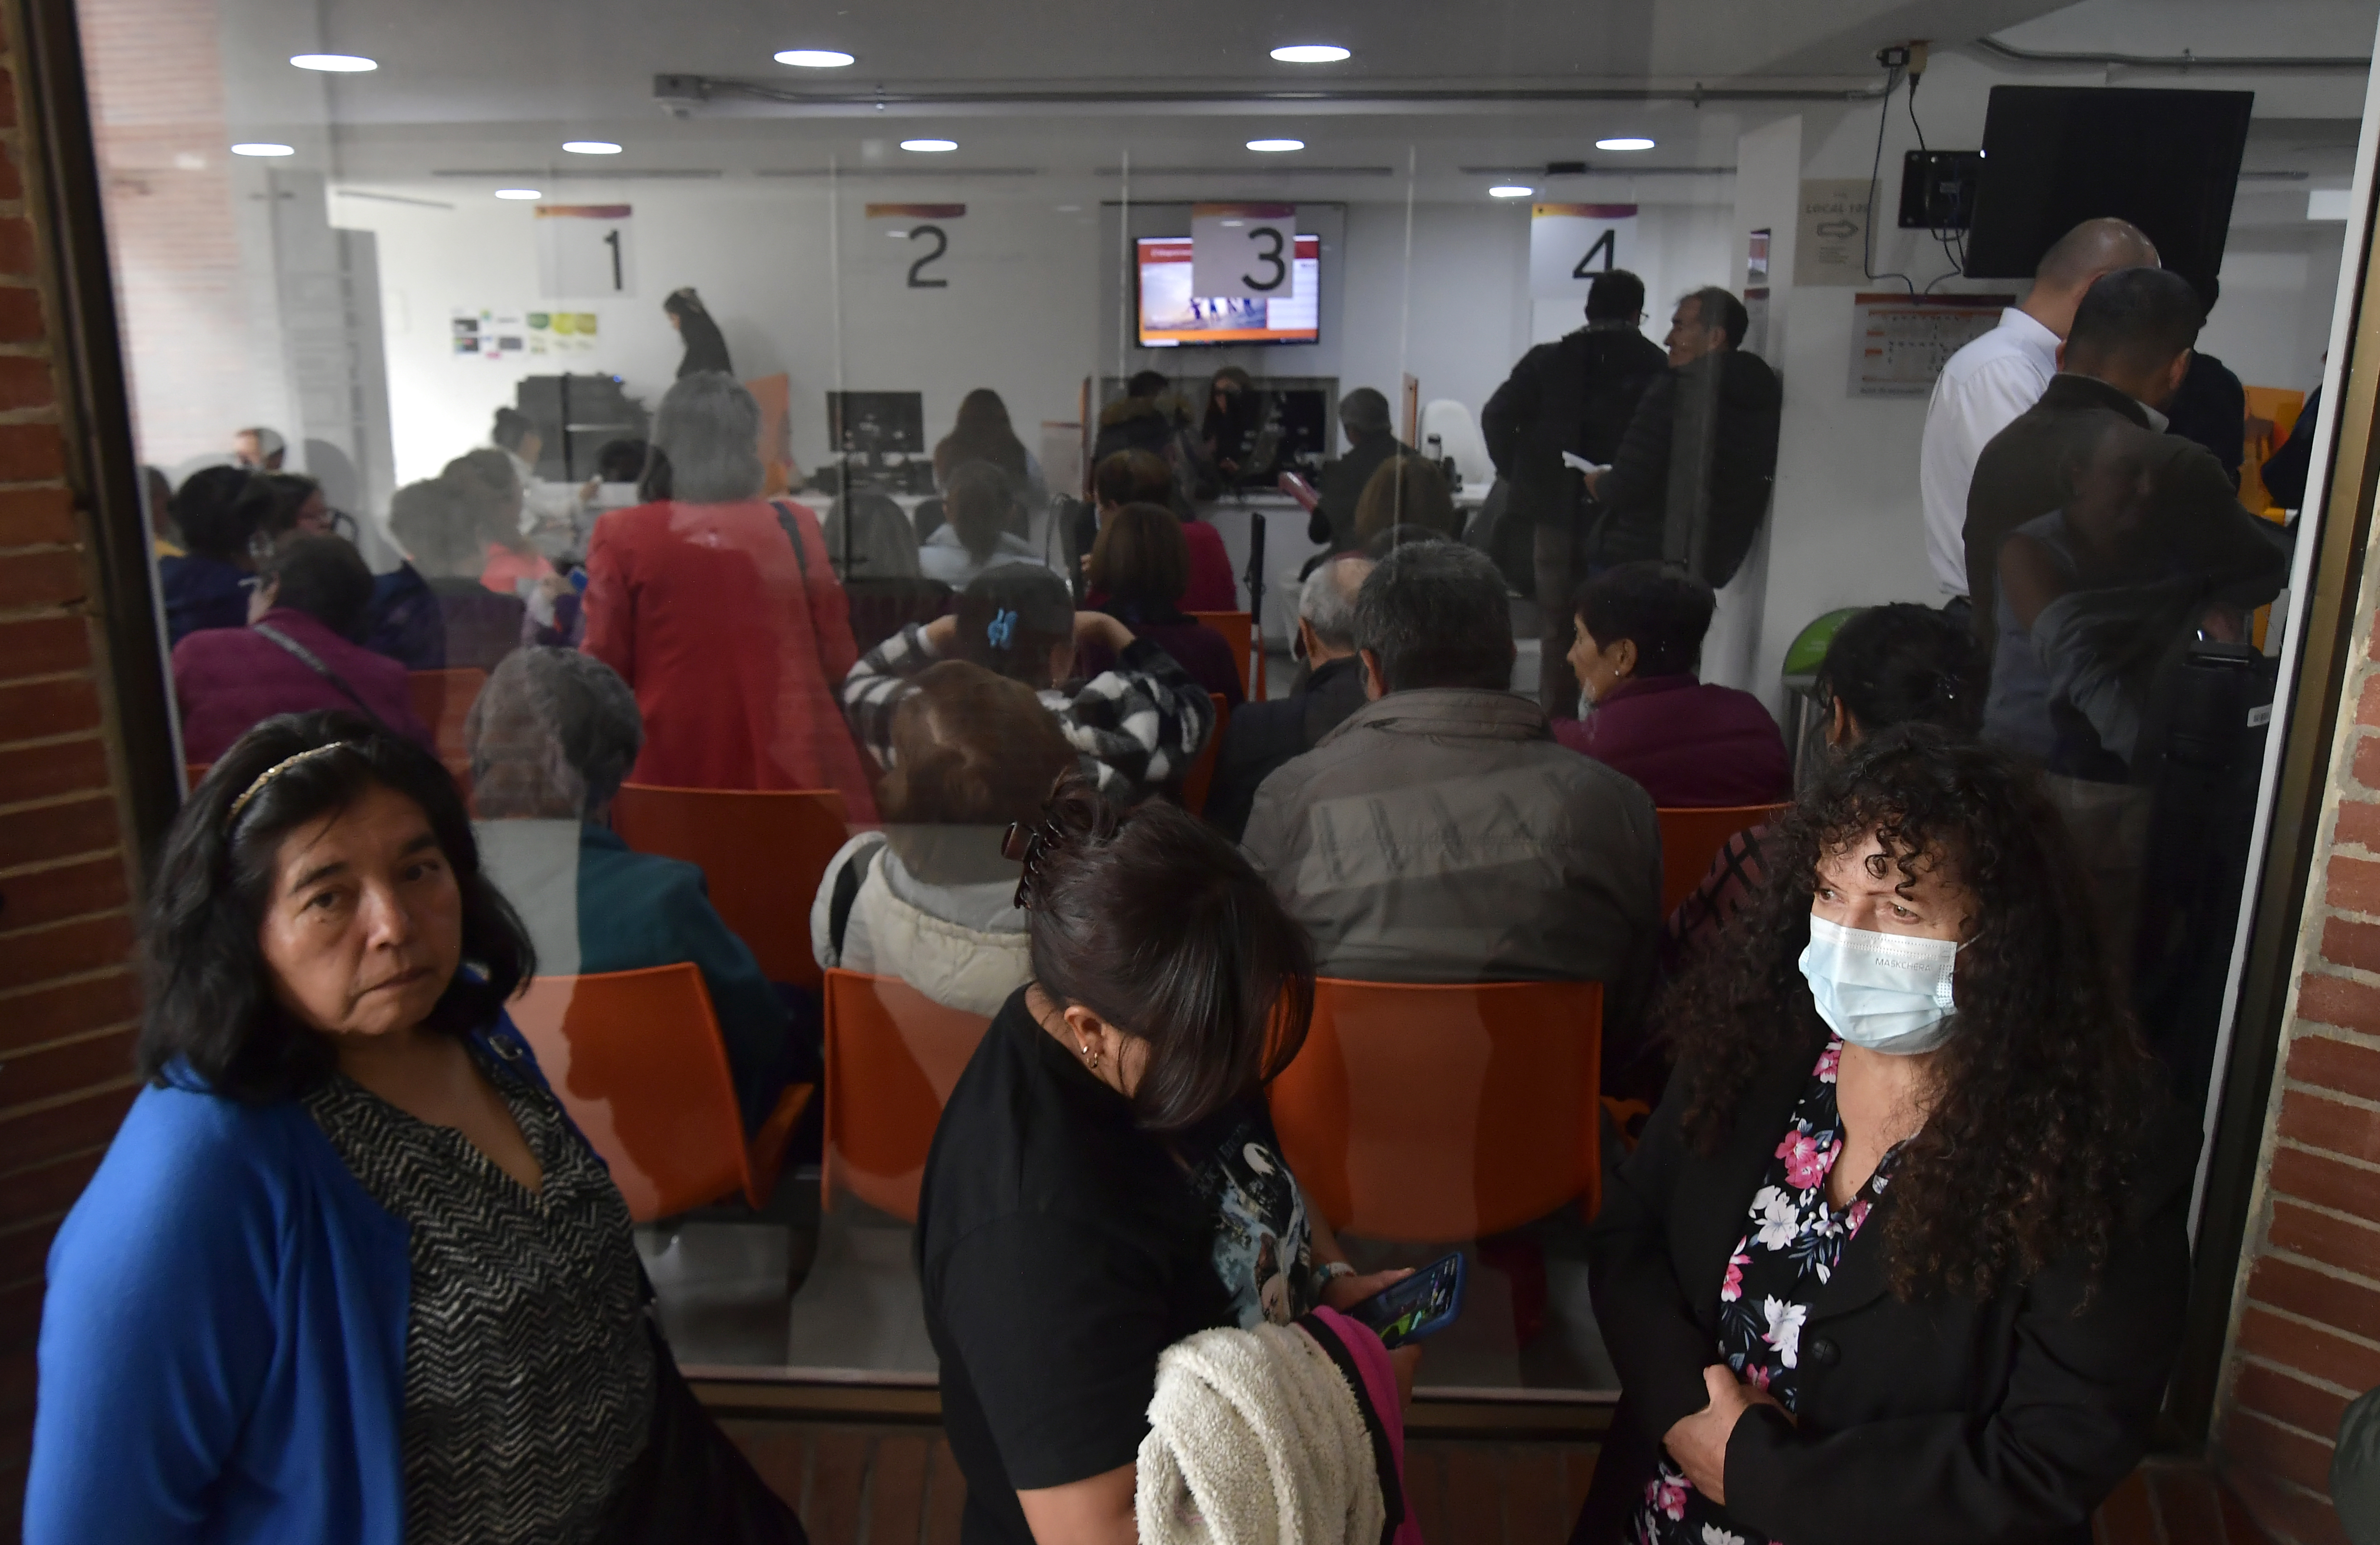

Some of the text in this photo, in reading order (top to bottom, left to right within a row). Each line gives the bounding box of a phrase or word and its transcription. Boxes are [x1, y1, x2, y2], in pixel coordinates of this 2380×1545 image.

[603, 229, 623, 290] 1
[907, 225, 949, 288] 2
[1242, 227, 1286, 292] 3
[1572, 229, 1614, 279] 4
[1875, 958, 1930, 972] MASKCHERA
